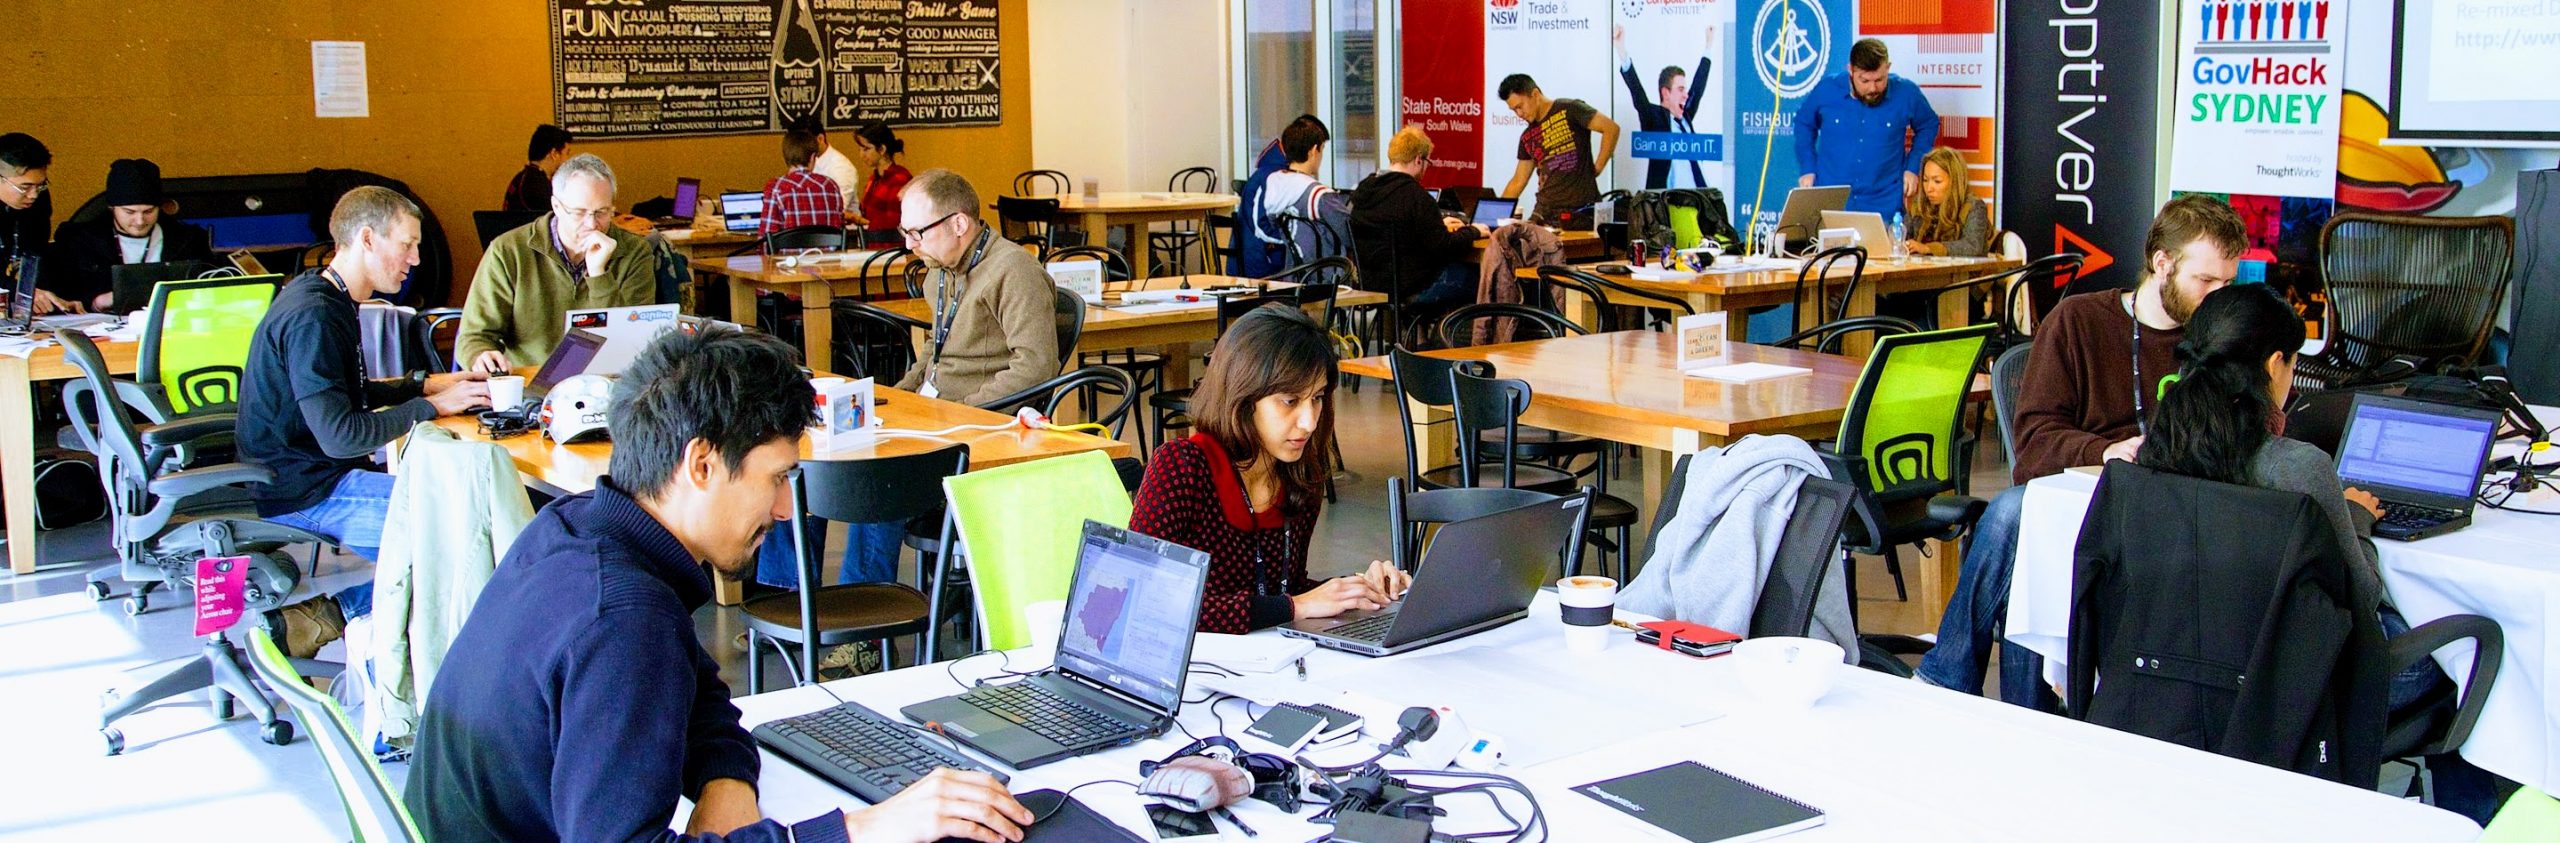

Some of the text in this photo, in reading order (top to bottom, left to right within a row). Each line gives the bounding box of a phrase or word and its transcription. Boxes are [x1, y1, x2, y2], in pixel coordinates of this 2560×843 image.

[668, 5, 771, 13] CONSTANTLY DISCOVERING
[906, 1, 946, 19] Thrill
[960, 1, 997, 20] Game
[1528, 2, 1568, 14] Trade &
[621, 9, 666, 22] CASUAL
[677, 13, 720, 22] PUSHING
[722, 13, 742, 22] NEW
[745, 13, 772, 22] IDEAS
[1491, 11, 1518, 25] NSW
[562, 9, 621, 38] FUN
[1528, 16, 1589, 30] Investment
[622, 24, 693, 37] ATMOSPHERE
[856, 25, 881, 39] Great
[906, 27, 997, 39] GOOD MANAGER
[564, 45, 592, 54] HIGHLY
[646, 45, 677, 53] SIMILAR
[679, 45, 707, 53] MINDED
[717, 45, 750, 53] FOCUSED
[752, 45, 771, 53] TEAM
[835, 37, 901, 50] Company Perks
[629, 57, 769, 75] Dynamic Environment
[907, 58, 977, 73] WORK LIFE
[1917, 64, 1982, 74] INTERSECT
[2193, 56, 2327, 85] GovHack
[834, 73, 903, 95] FUN WORK
[907, 74, 977, 91] BALANCE
[566, 84, 717, 101] Fresh & Interesting Challenges
[724, 86, 766, 95] AUTONOMY
[780, 86, 816, 103] SYDNEY
[670, 101, 718, 109] CONTRIBUTE
[720, 100, 731, 108] TO
[739, 99, 760, 107] TEAM
[908, 94, 998, 105] ALWAYS SOMETHING
[1403, 96, 1481, 116] State Records
[663, 108, 767, 118] WHICH MAKES A DIFFERENCE
[833, 96, 858, 119] &
[908, 104, 998, 119] NEW TO LEARN
[2191, 93, 2327, 125] SYDNEY
[858, 110, 901, 121] Benefits
[1743, 111, 1796, 127] FISHBU
[582, 123, 652, 133] GREAT TEAM ETHIC
[660, 121, 716, 130] CONTINUOUSLY
[1426, 119, 1449, 131] South
[1450, 120, 1472, 132] Wales
[1634, 137, 1717, 155] Gain a job in IT.
